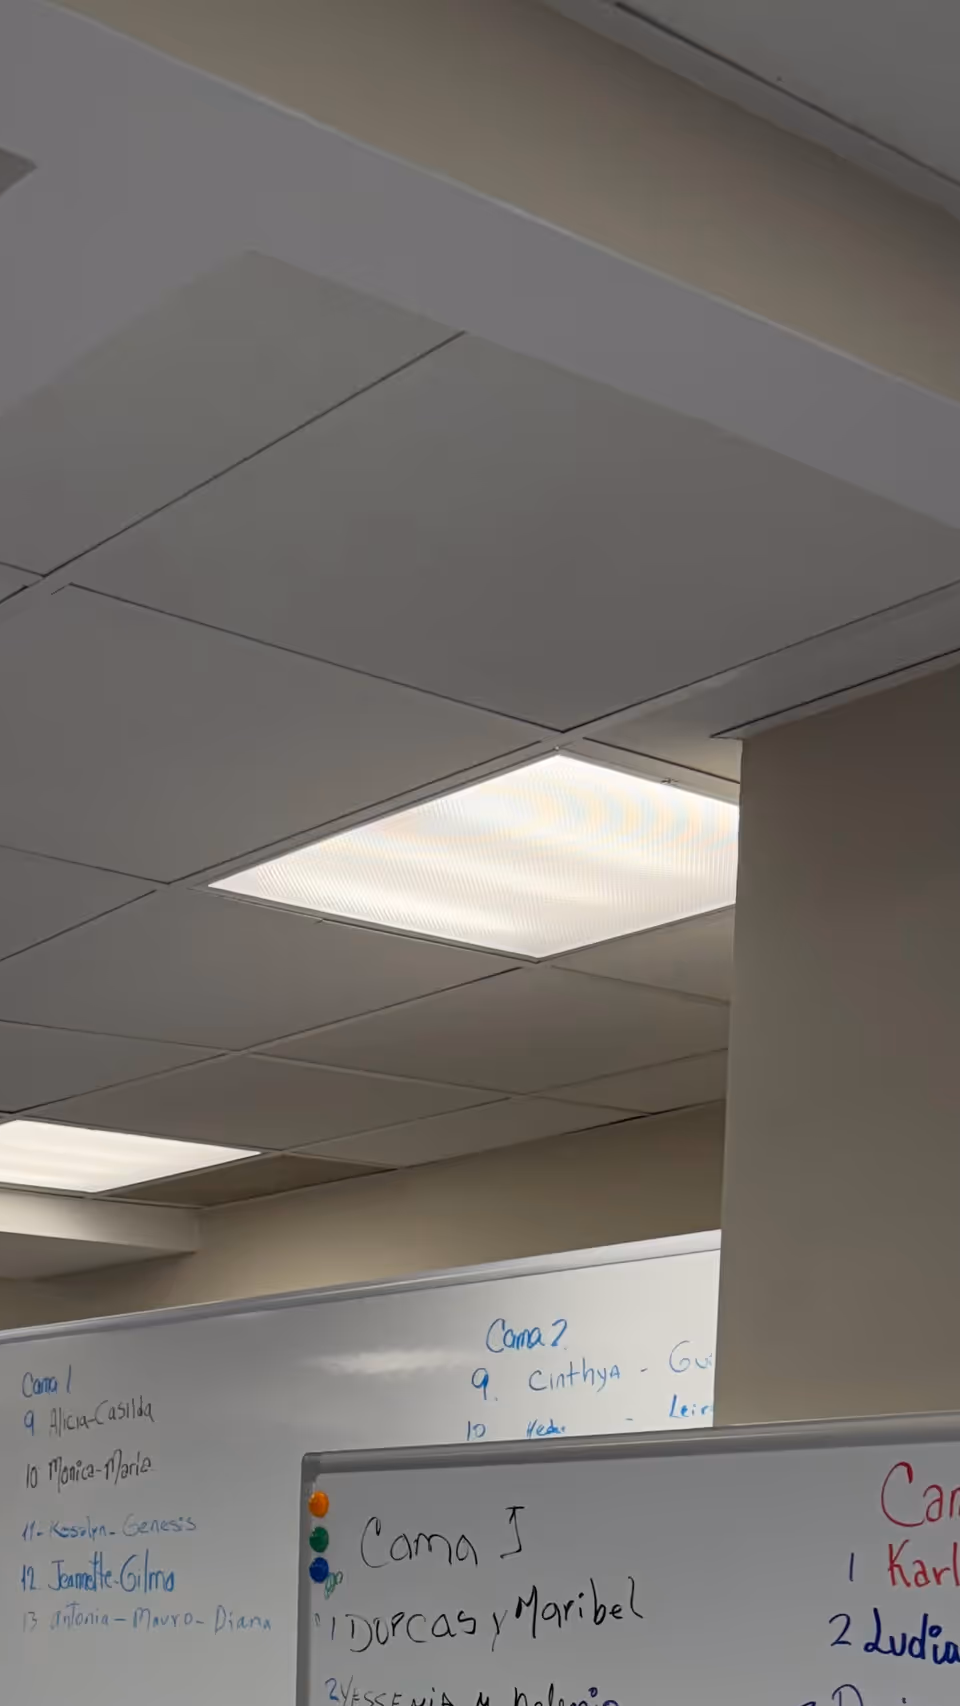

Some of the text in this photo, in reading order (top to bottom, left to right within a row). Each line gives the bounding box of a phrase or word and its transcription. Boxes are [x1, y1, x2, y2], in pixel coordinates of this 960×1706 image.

[486, 1318, 567, 1353] Cama 2
[22, 1372, 58, 1398] Cama
[24, 1410, 34, 1436] 9
[467, 1420, 486, 1441] 10
[26, 1463, 38, 1488] 10
[361, 1516, 479, 1568] Cama
[21, 1564, 36, 1592] 12
[514, 1576, 643, 1640] Maribel
[828, 1613, 852, 1647] 2
